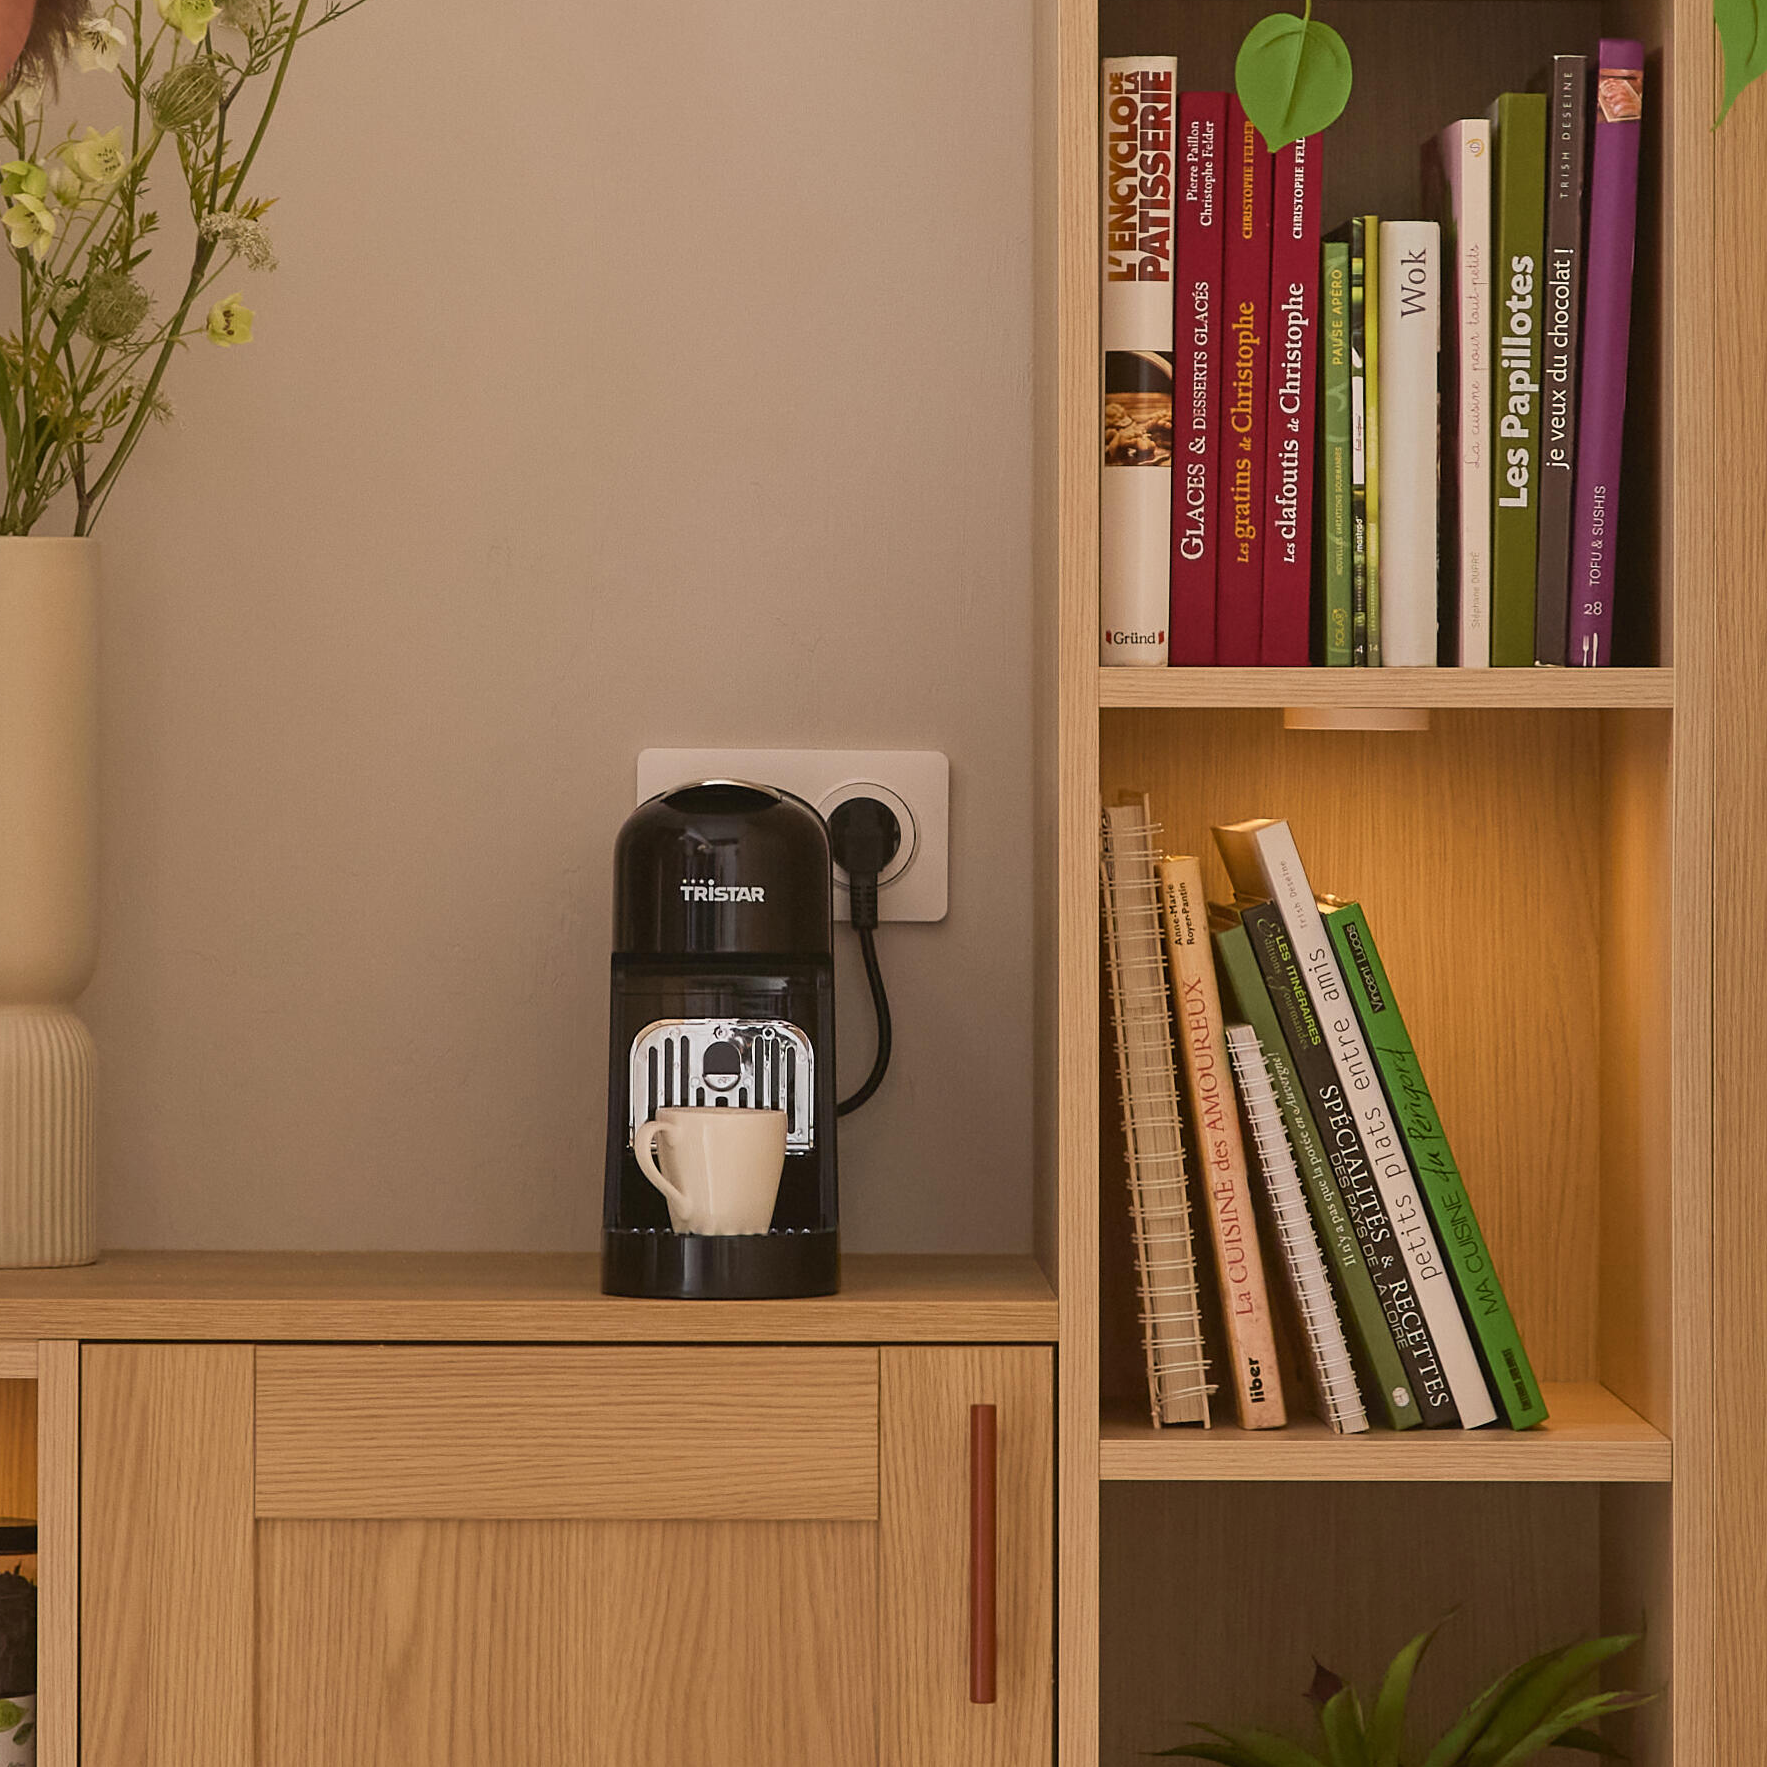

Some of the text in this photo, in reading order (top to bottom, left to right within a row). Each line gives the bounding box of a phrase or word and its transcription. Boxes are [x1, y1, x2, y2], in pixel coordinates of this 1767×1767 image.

[1108, 70, 1140, 282] L'ENCYCLO DE LA
[1138, 71, 1172, 282] PATISSERIE
[1186, 121, 1200, 201] Pierre Paillon
[1200, 121, 1216, 227] Christophe Felder
[1559, 72, 1573, 199] TRISH DESEINE
[1242, 163, 1254, 239] CHRISTOPHE
[1292, 166, 1305, 239] CHRISTOPHE
[1400, 248, 1427, 319] Wok
[1547, 259, 1571, 348] chocolat
[1332, 319, 1344, 366] PAUSE
[1464, 243, 1489, 468] La cuisine pour tout-petits
[1498, 255, 1539, 508] Les Papillotes
[1546, 353, 1568, 382] du
[1181, 281, 1209, 560] GLACES & DESSERTS GLACÉS
[1230, 301, 1260, 563] Les gratins de Christophe
[1274, 283, 1309, 563] Les clafoutis de Christophe
[1546, 449, 1570, 470] je
[1550, 390, 1567, 442] veux
[1589, 485, 1606, 586] TOFU & SUSHIS
[1113, 631, 1156, 645] Gründ
[1583, 601, 1603, 616] 28
[680, 879, 765, 902] TRISTAR
[1168, 883, 1183, 946] Anne-Marie
[1179, 882, 1195, 946] Royer-Pantin
[1275, 935, 1322, 1047] LES ITINÉRAIRES
[1346, 923, 1384, 1012] Vincent Lucas
[1184, 976, 1254, 1317] La CUISINE des AMOUREUX
[1295, 1116, 1306, 1130] en
[1308, 948, 1443, 1281] petits plats entre amis
[1319, 1180, 1335, 1202] que
[1327, 1203, 1344, 1225] pas
[1376, 1047, 1500, 1316] MA CUISINE du Périgord
[1319, 1084, 1450, 1409] SPÉCIALITÉS & RECETTES
[1330, 1152, 1409, 1350] DES PAYS DE LA LOIRE
[1249, 1356, 1266, 1404] liber
